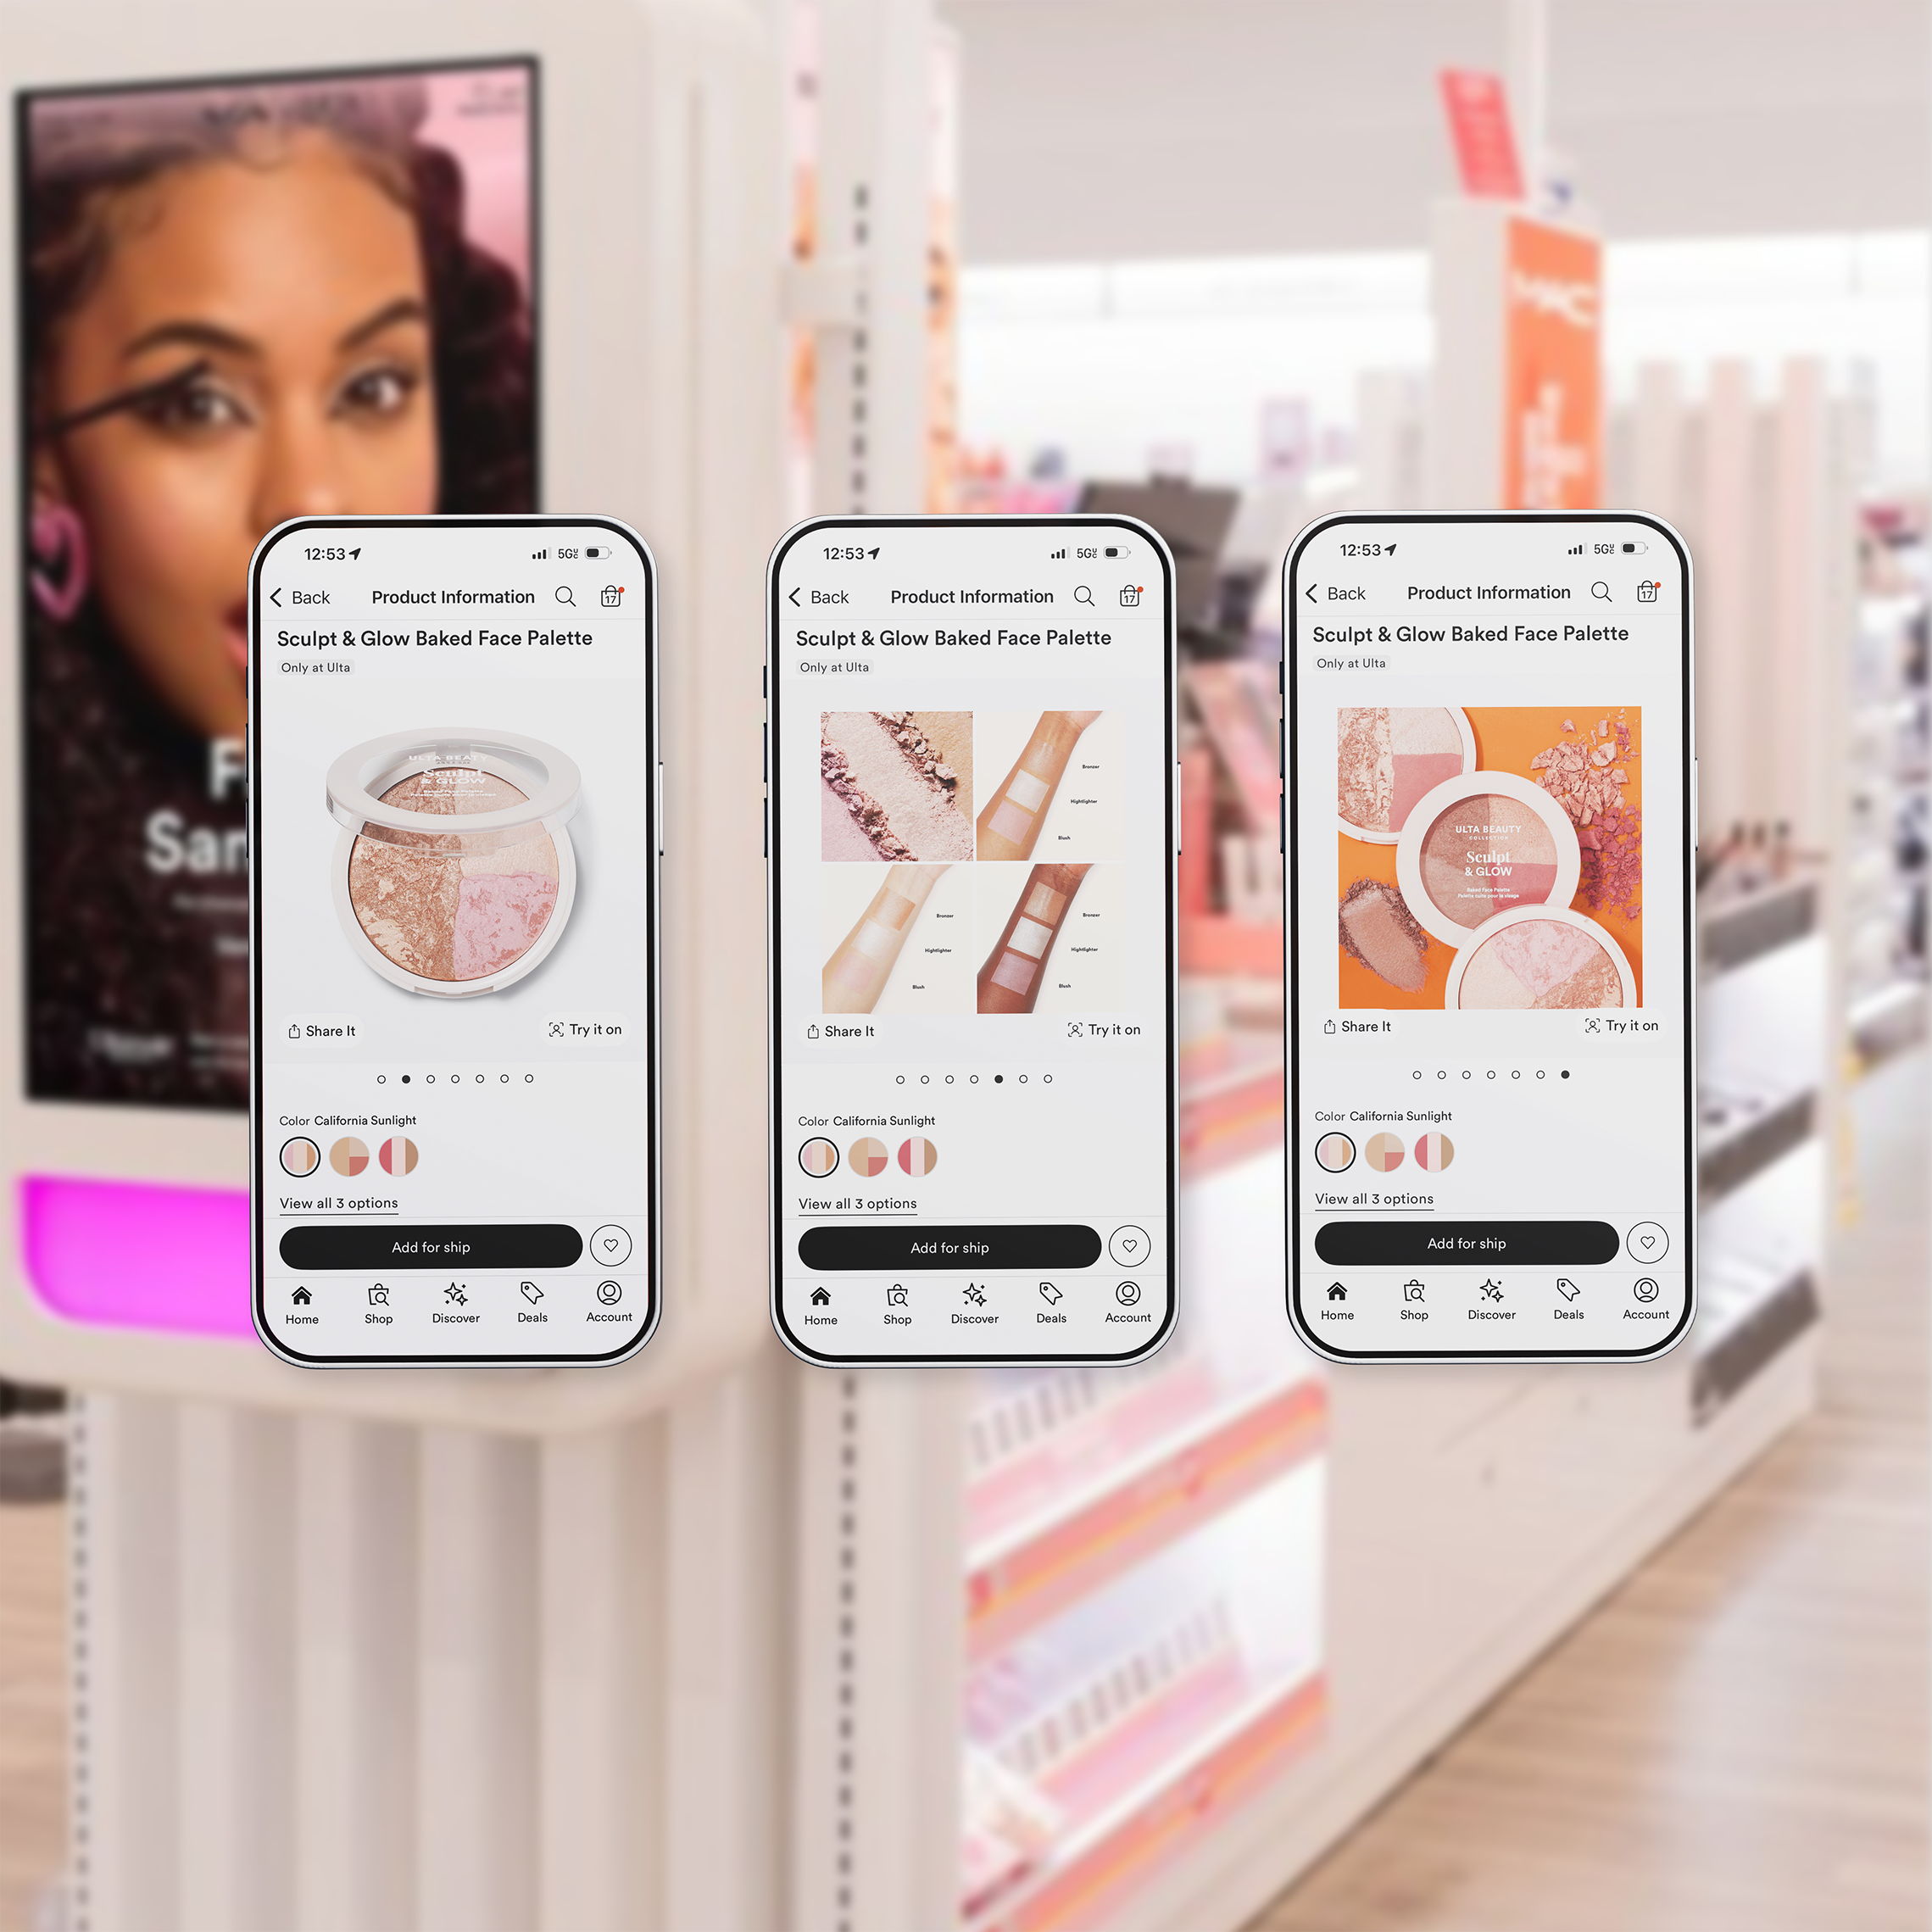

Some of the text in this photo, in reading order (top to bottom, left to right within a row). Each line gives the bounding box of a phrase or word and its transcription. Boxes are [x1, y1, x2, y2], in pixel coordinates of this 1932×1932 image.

[303, 547, 346, 561] 12:53
[822, 547, 865, 560] 12:53
[1339, 543, 1382, 557] 12:53
[292, 589, 331, 605] Back
[372, 588, 535, 604] Product Information
[604, 593, 617, 604] 17
[811, 589, 849, 604] Back
[891, 588, 1054, 604] Product Information
[1123, 594, 1136, 604] 17
[1328, 586, 1367, 601] Back
[1407, 584, 1571, 600] Product Information
[1641, 590, 1653, 599] 17
[276, 629, 593, 651] Sculpt & Glow Baked Face Palette
[796, 628, 1112, 650] Sculpt & Glow Baked Face Palette
[1312, 624, 1629, 647] Sculpt & Glow Baked Face Palette
[281, 661, 350, 676] Only at Ulta
[799, 661, 869, 675] Only at Ulta
[1317, 658, 1386, 671] Only at Ulta
[423, 768, 484, 778] Sculpt
[1456, 825, 1522, 833] ULTA BEAUTY
[1466, 849, 1512, 866] Sculpt
[1464, 866, 1512, 877] & GLOW
[305, 1024, 356, 1038] Share It
[569, 1022, 622, 1038] Try it on
[824, 1025, 875, 1038] Share It
[1088, 1023, 1141, 1038] Try it on
[1341, 1020, 1392, 1033] Share It
[1605, 1019, 1659, 1034] Try it on
[279, 1114, 417, 1128] Color California Sunlight
[798, 1115, 936, 1128] Color California Sunlight
[1314, 1110, 1453, 1124] Color California Sunlight
[279, 1196, 398, 1211] View all 3 options
[798, 1197, 917, 1212] View all 3 options
[1314, 1192, 1434, 1207] View all 3 options
[391, 1240, 470, 1256] Add for ship
[910, 1241, 989, 1256] Add for ship
[1427, 1237, 1506, 1252] Add for ship
[286, 1314, 320, 1325] Home
[365, 1313, 393, 1327] Shop
[432, 1312, 481, 1323] Discover
[517, 1311, 548, 1323] Deals
[586, 1311, 633, 1322] Account
[805, 1315, 838, 1326] Home
[883, 1314, 912, 1327] Shop
[951, 1313, 999, 1324] Discover
[1036, 1312, 1067, 1323] Deals
[1105, 1312, 1152, 1323] Account
[1321, 1310, 1355, 1321] Home
[1400, 1309, 1429, 1322] Shop
[1467, 1309, 1517, 1320] Discover
[1554, 1309, 1584, 1320] Deals
[1623, 1309, 1670, 1320] Account
